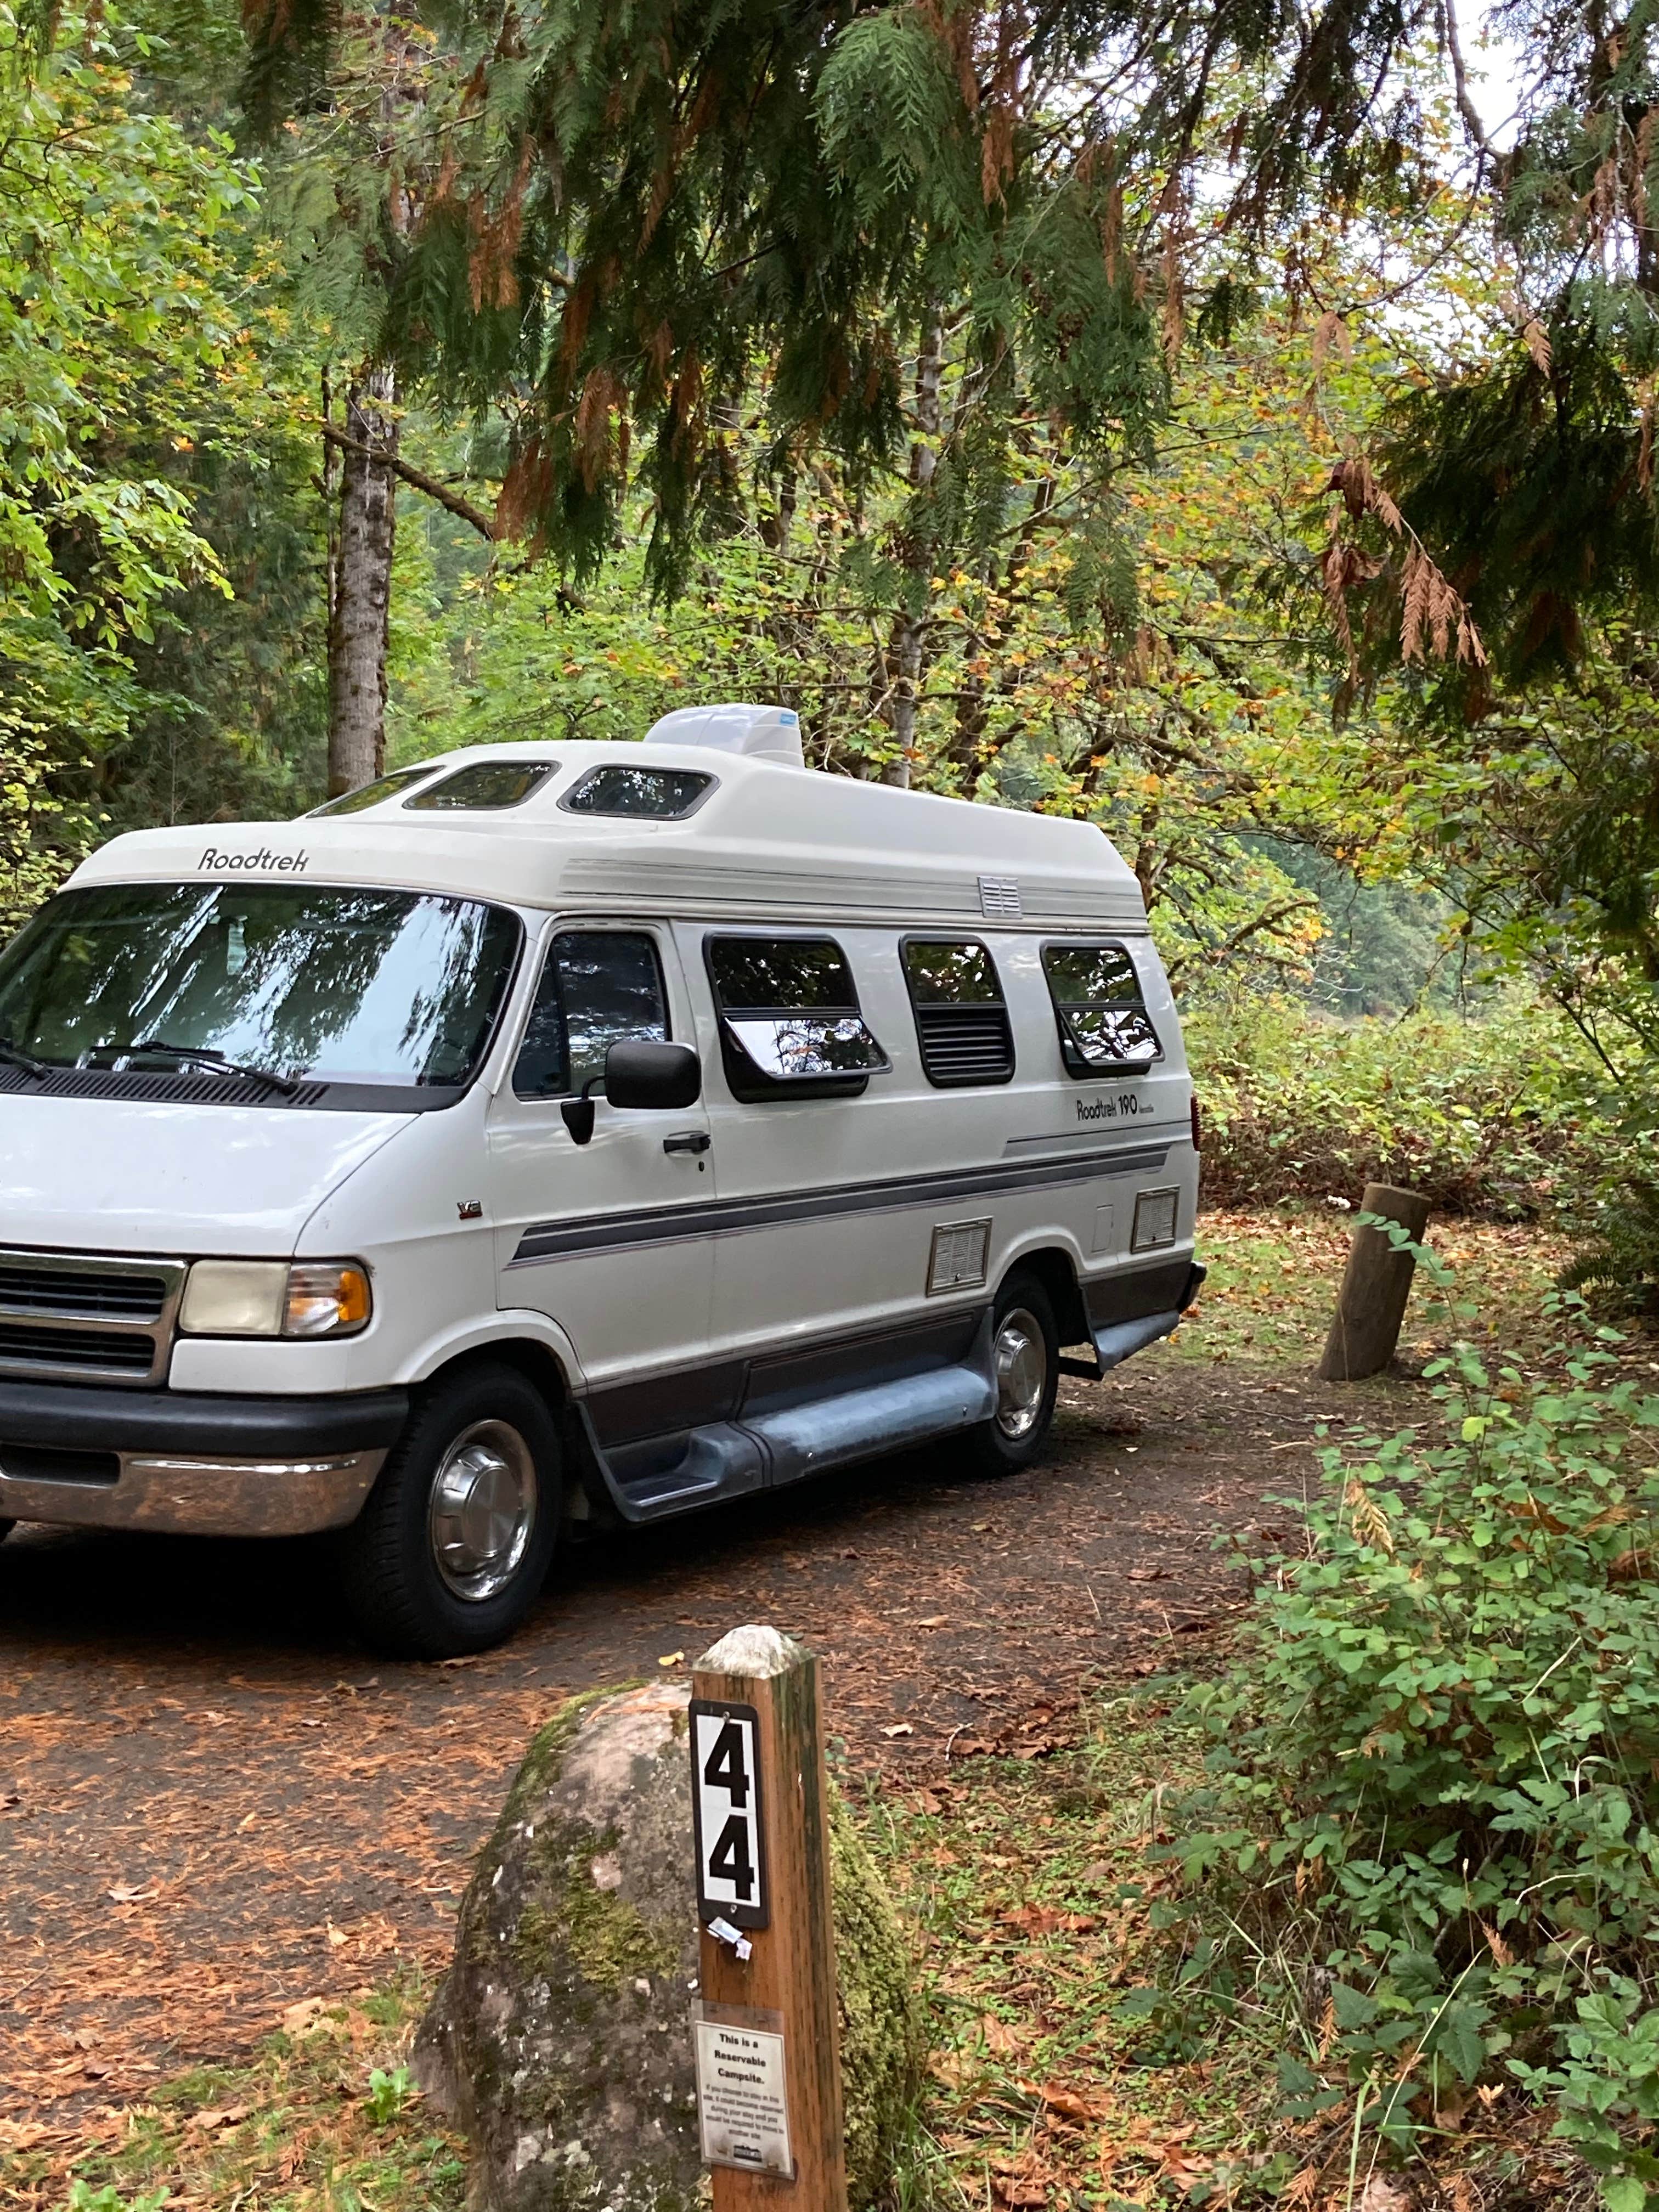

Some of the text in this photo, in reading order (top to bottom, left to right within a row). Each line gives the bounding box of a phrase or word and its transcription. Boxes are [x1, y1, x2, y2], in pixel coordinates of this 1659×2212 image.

[198, 847, 309, 871] Roadtrek
[1076, 1097, 1117, 1121] Roadtrek
[1118, 1094, 1138, 1115] 190
[719, 2033, 739, 2045] This
[742, 2037, 750, 2047] is
[714, 2050, 766, 2067] Reservable
[718, 2068, 765, 2084] Campsite.
